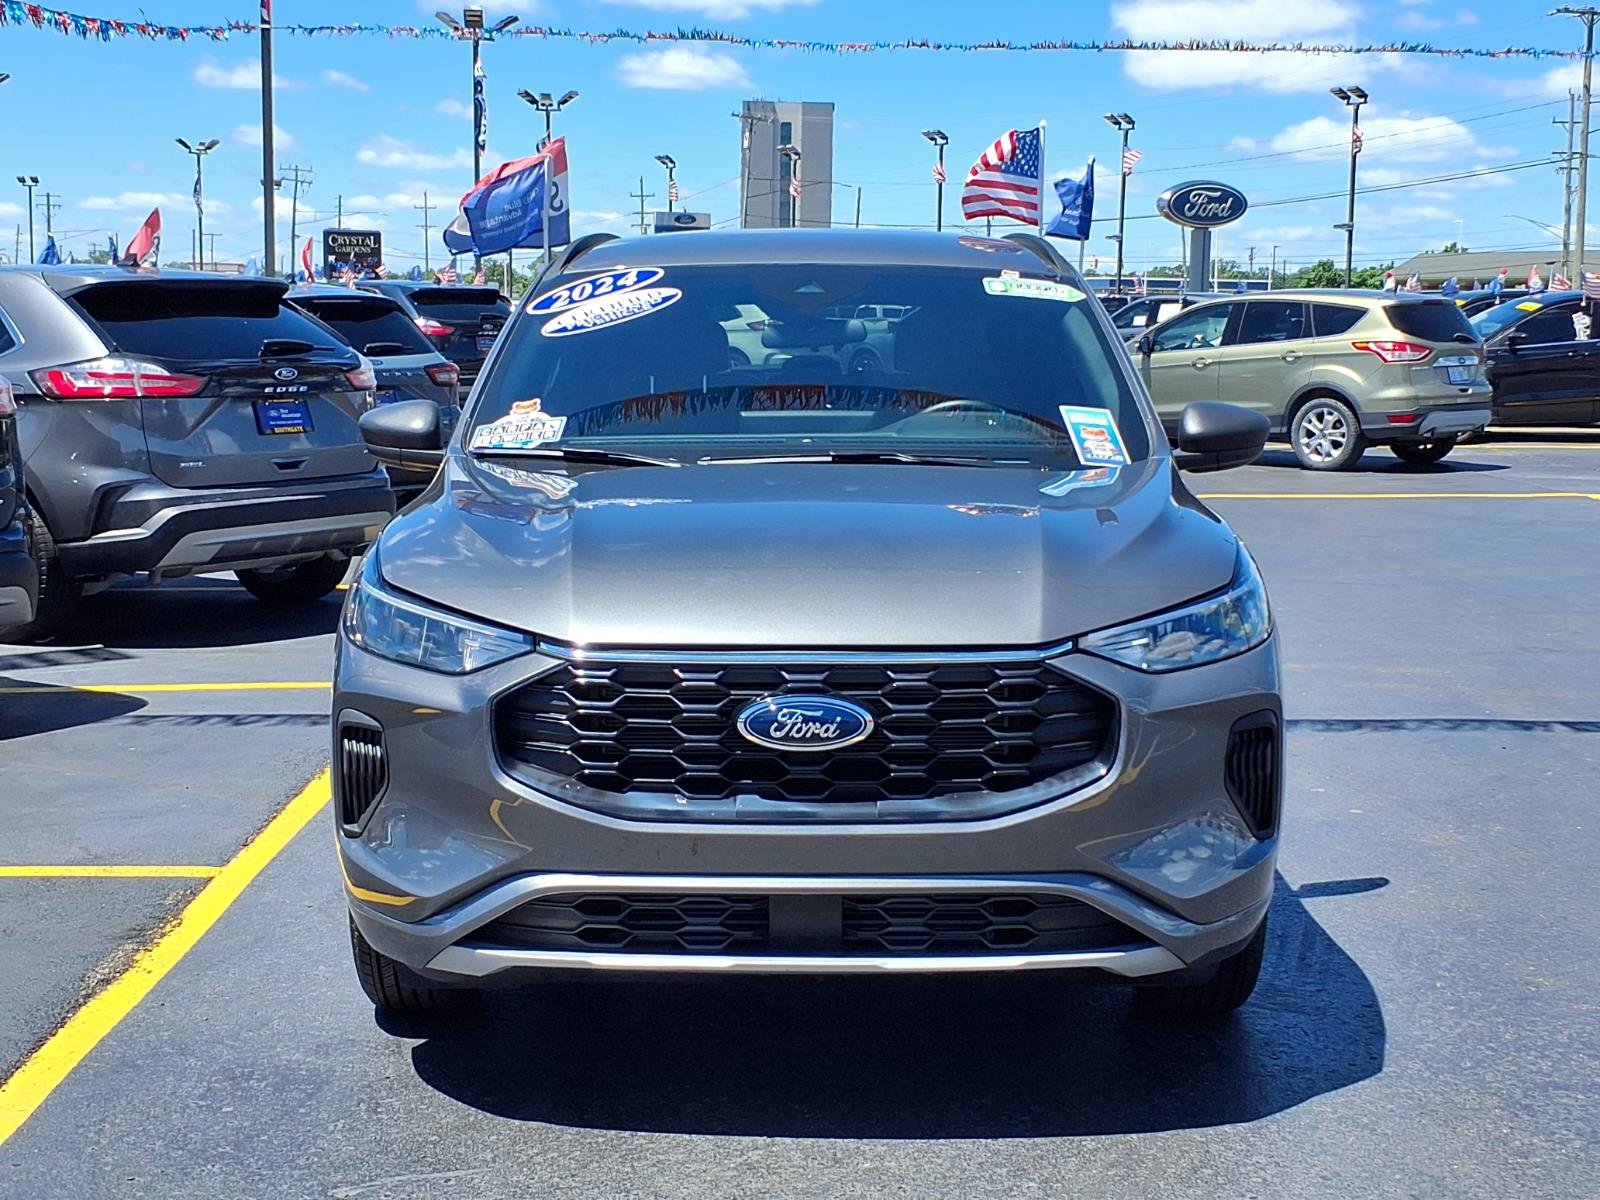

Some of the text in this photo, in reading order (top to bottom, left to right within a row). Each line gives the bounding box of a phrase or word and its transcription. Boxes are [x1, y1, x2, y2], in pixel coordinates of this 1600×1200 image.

[1184, 190, 1233, 217] Ford
[328, 234, 378, 248] CRYSTAL
[549, 270, 639, 309] 2024
[264, 385, 308, 393] EDGE
[770, 708, 841, 738] Ford
